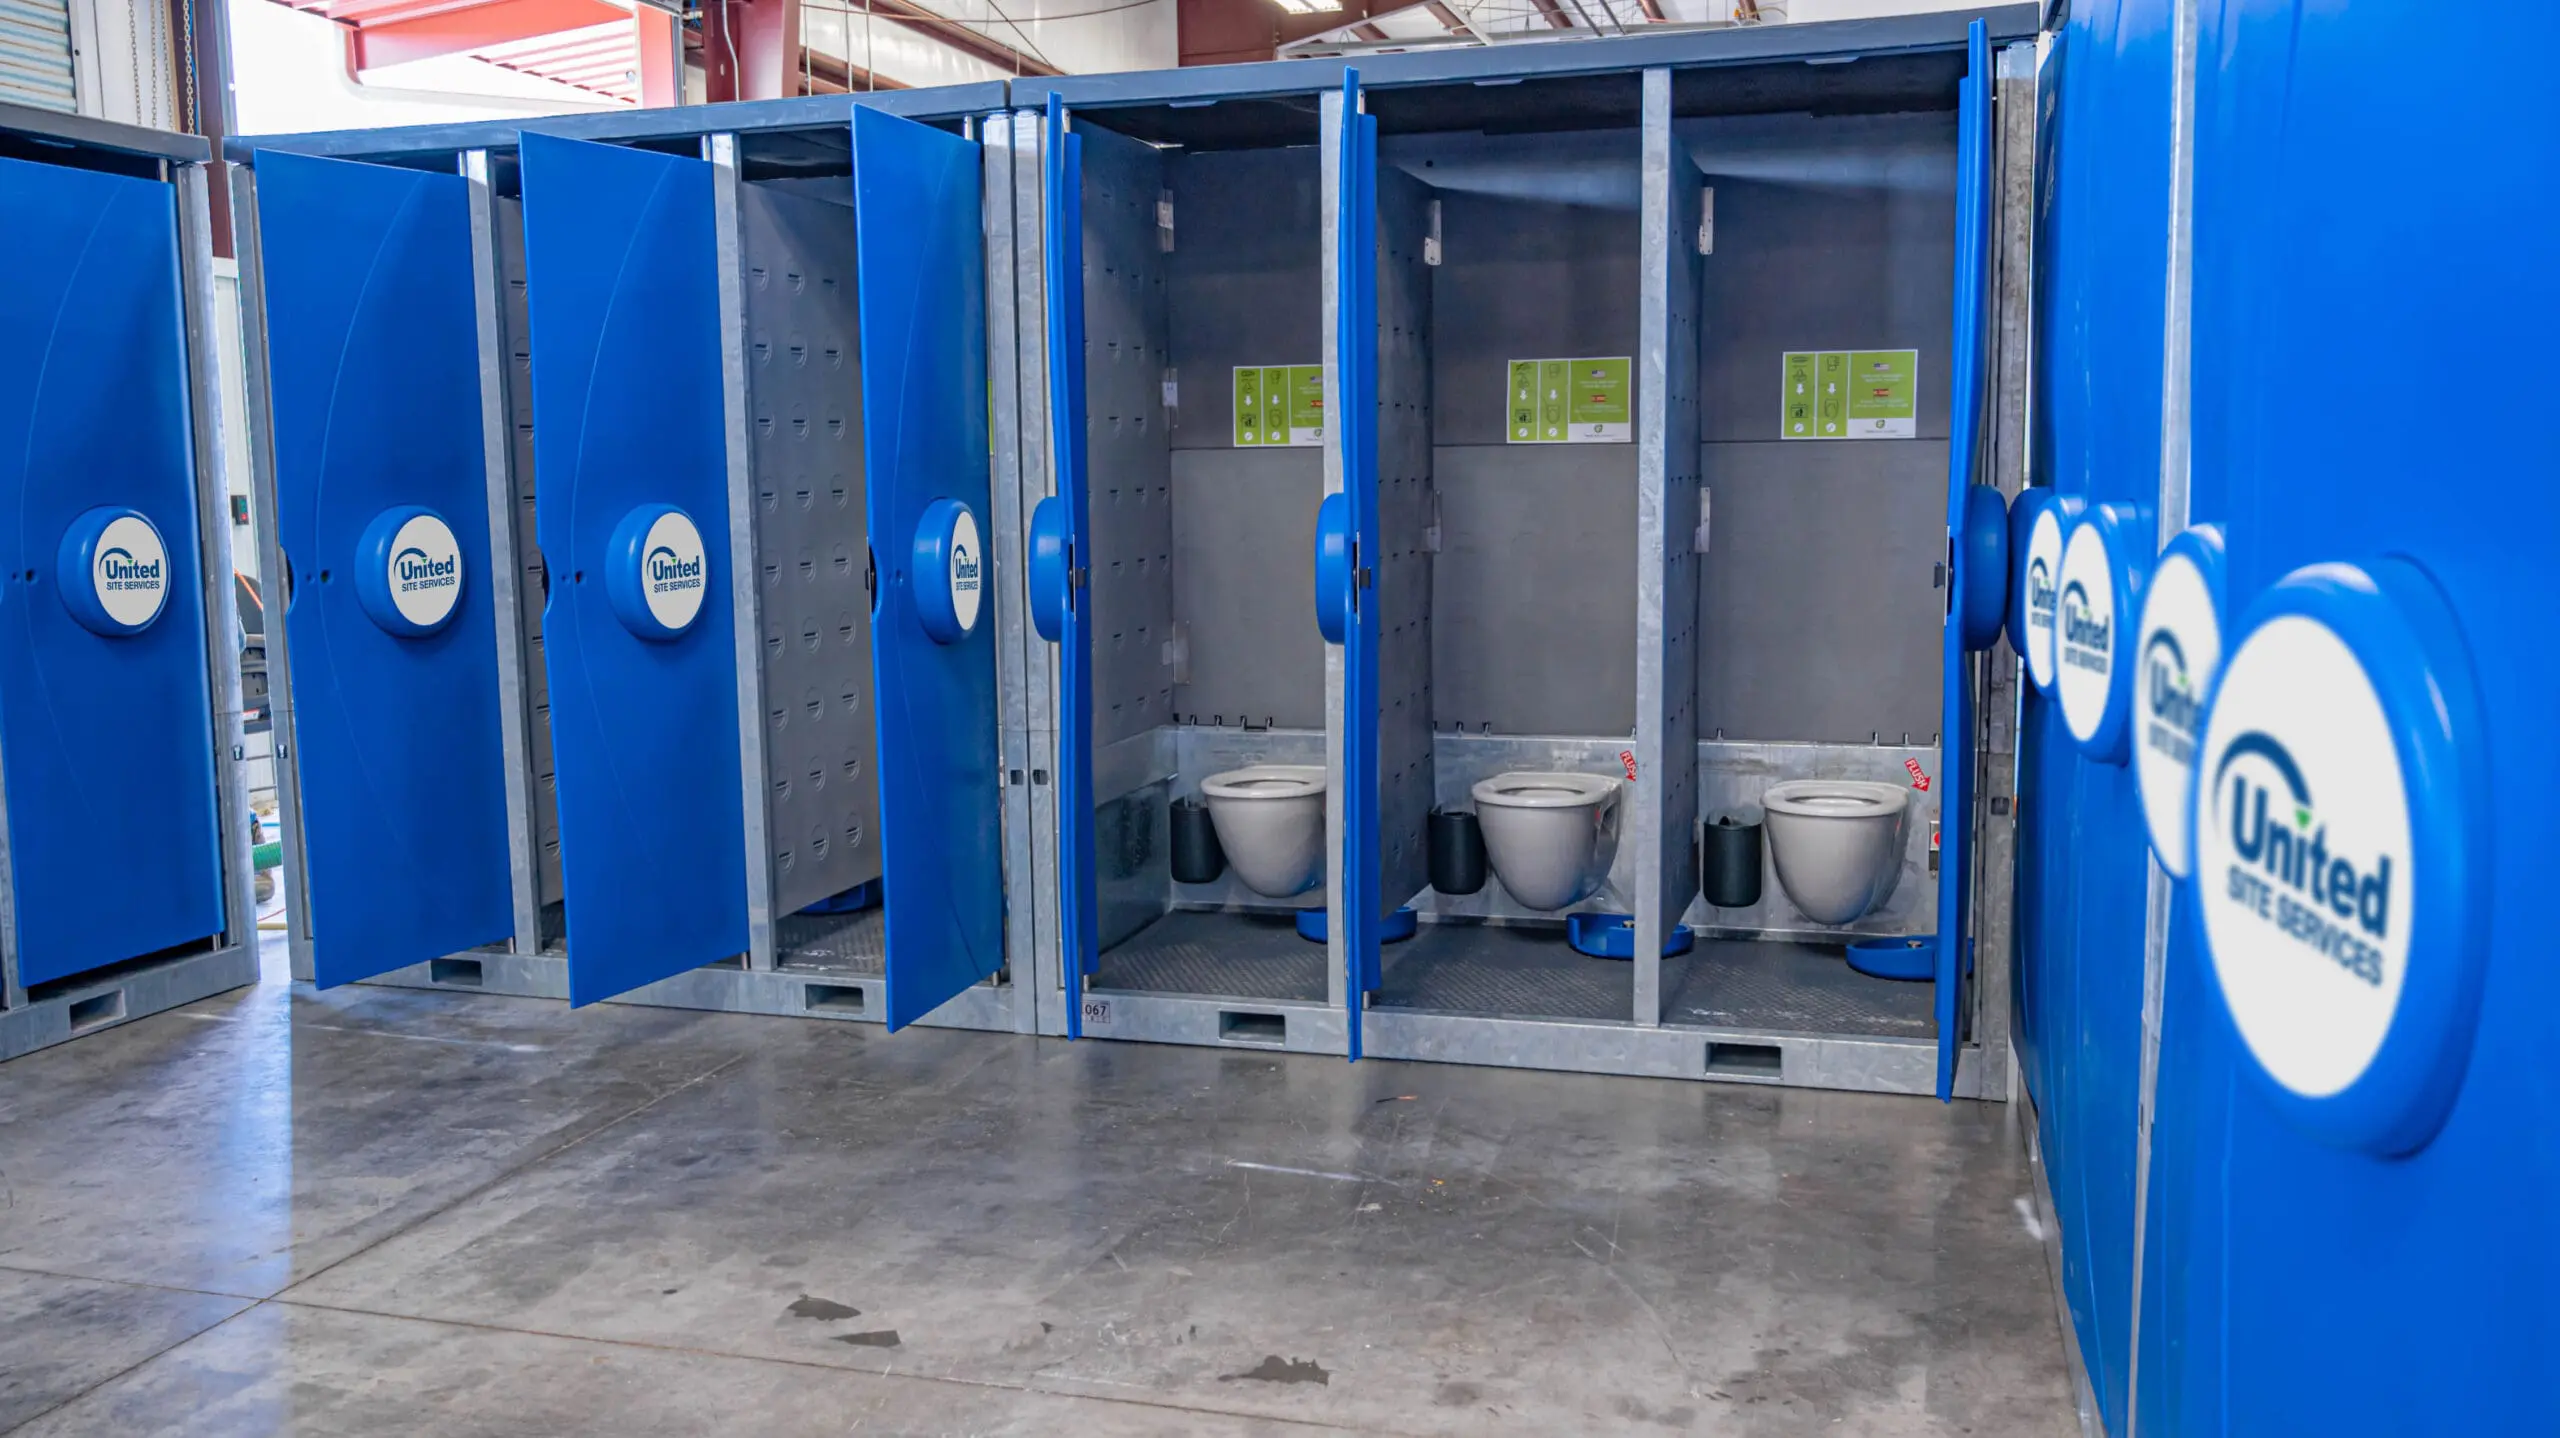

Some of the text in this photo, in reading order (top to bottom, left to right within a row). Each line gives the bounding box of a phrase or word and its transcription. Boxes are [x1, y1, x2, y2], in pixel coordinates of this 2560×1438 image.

[106, 559, 160, 579] United
[401, 555, 454, 580] United
[653, 555, 700, 581] United
[955, 557, 978, 579] United
[106, 581, 160, 590] SITE SERVICES
[401, 577, 455, 592] SITE SERVICES
[654, 578, 701, 593] SITE SERVICES
[2032, 576, 2057, 610] Unite
[2065, 603, 2109, 652] United
[1905, 758, 1929, 788] FLUSH
[2232, 774, 2392, 940] United
[2227, 864, 2384, 988] SITE SERVICES
